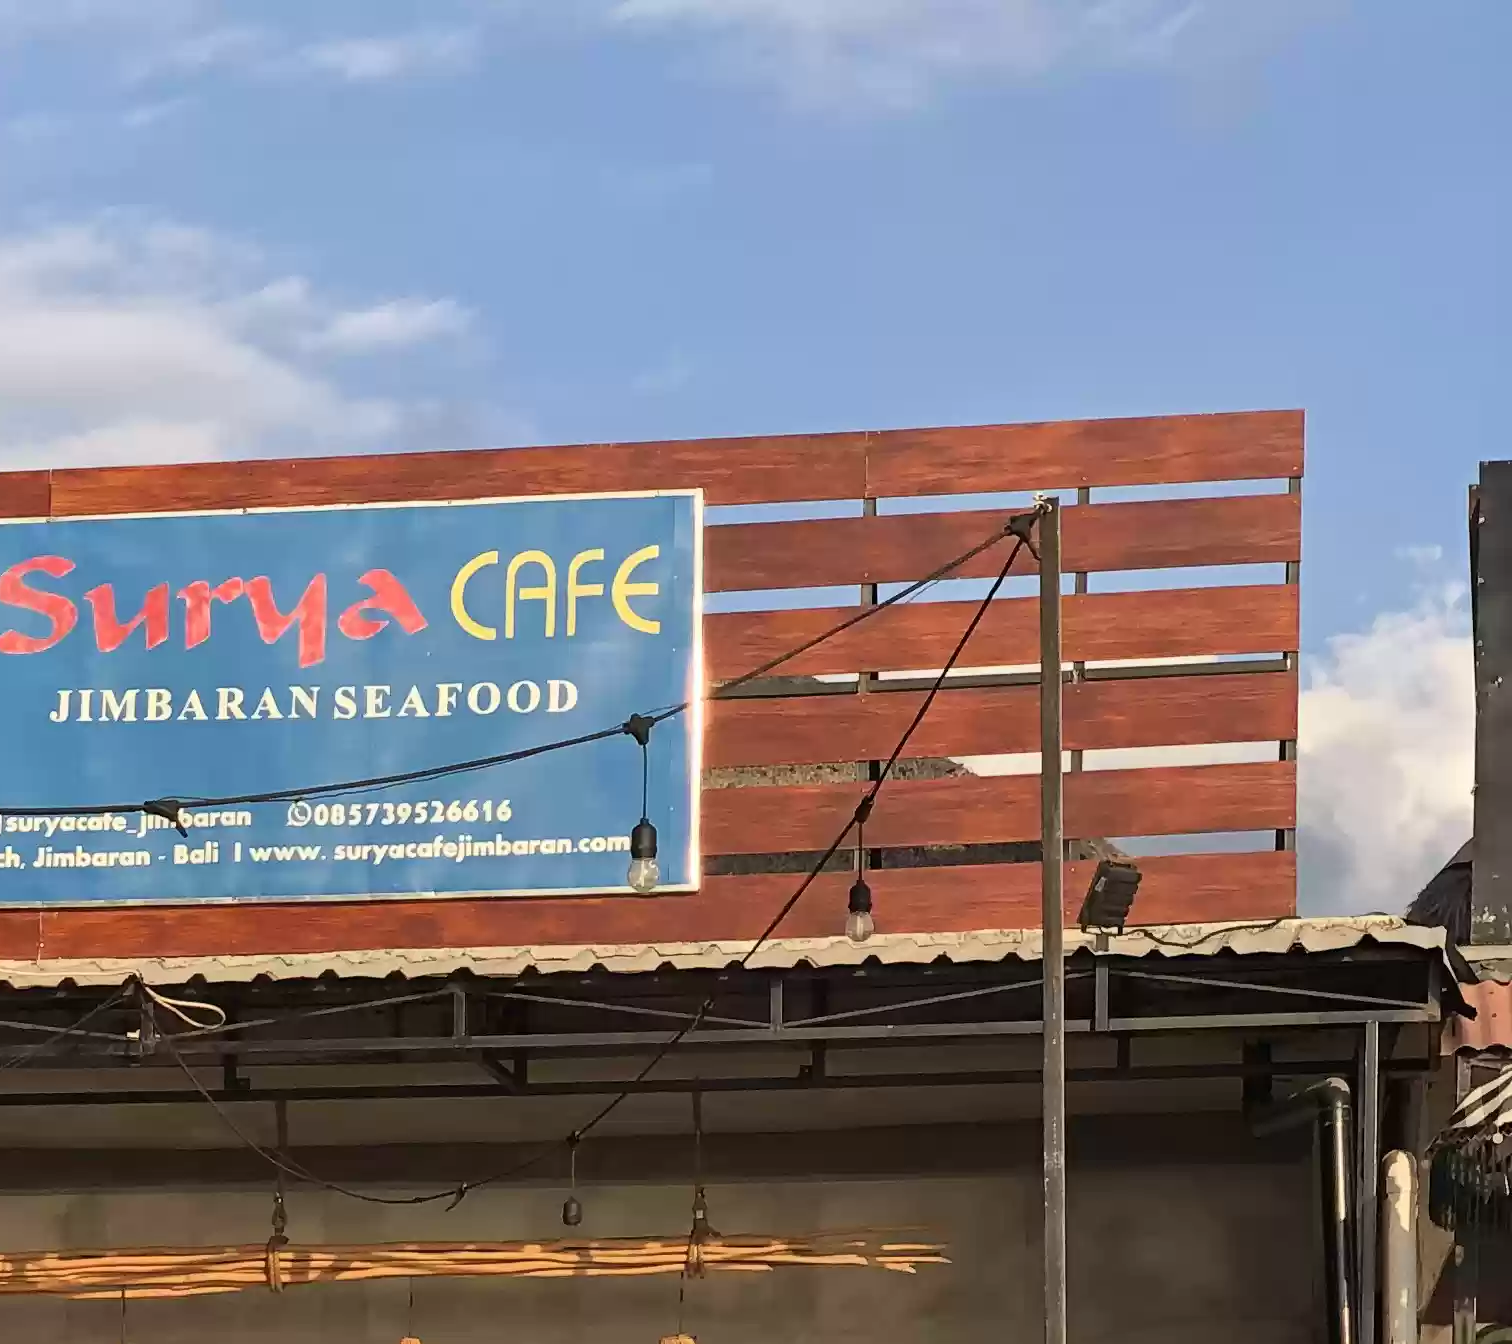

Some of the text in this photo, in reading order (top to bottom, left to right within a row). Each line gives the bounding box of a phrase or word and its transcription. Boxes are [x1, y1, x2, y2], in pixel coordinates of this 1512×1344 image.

[450, 545, 661, 640] CAFE
[49, 678, 580, 724] JIMBARAN SEAFOOD
[314, 799, 513, 826] 085739526616
[32, 845, 151, 869] Jimbaran
[173, 841, 219, 865] Bali
[333, 833, 631, 866] suryacafejimbaran.com
